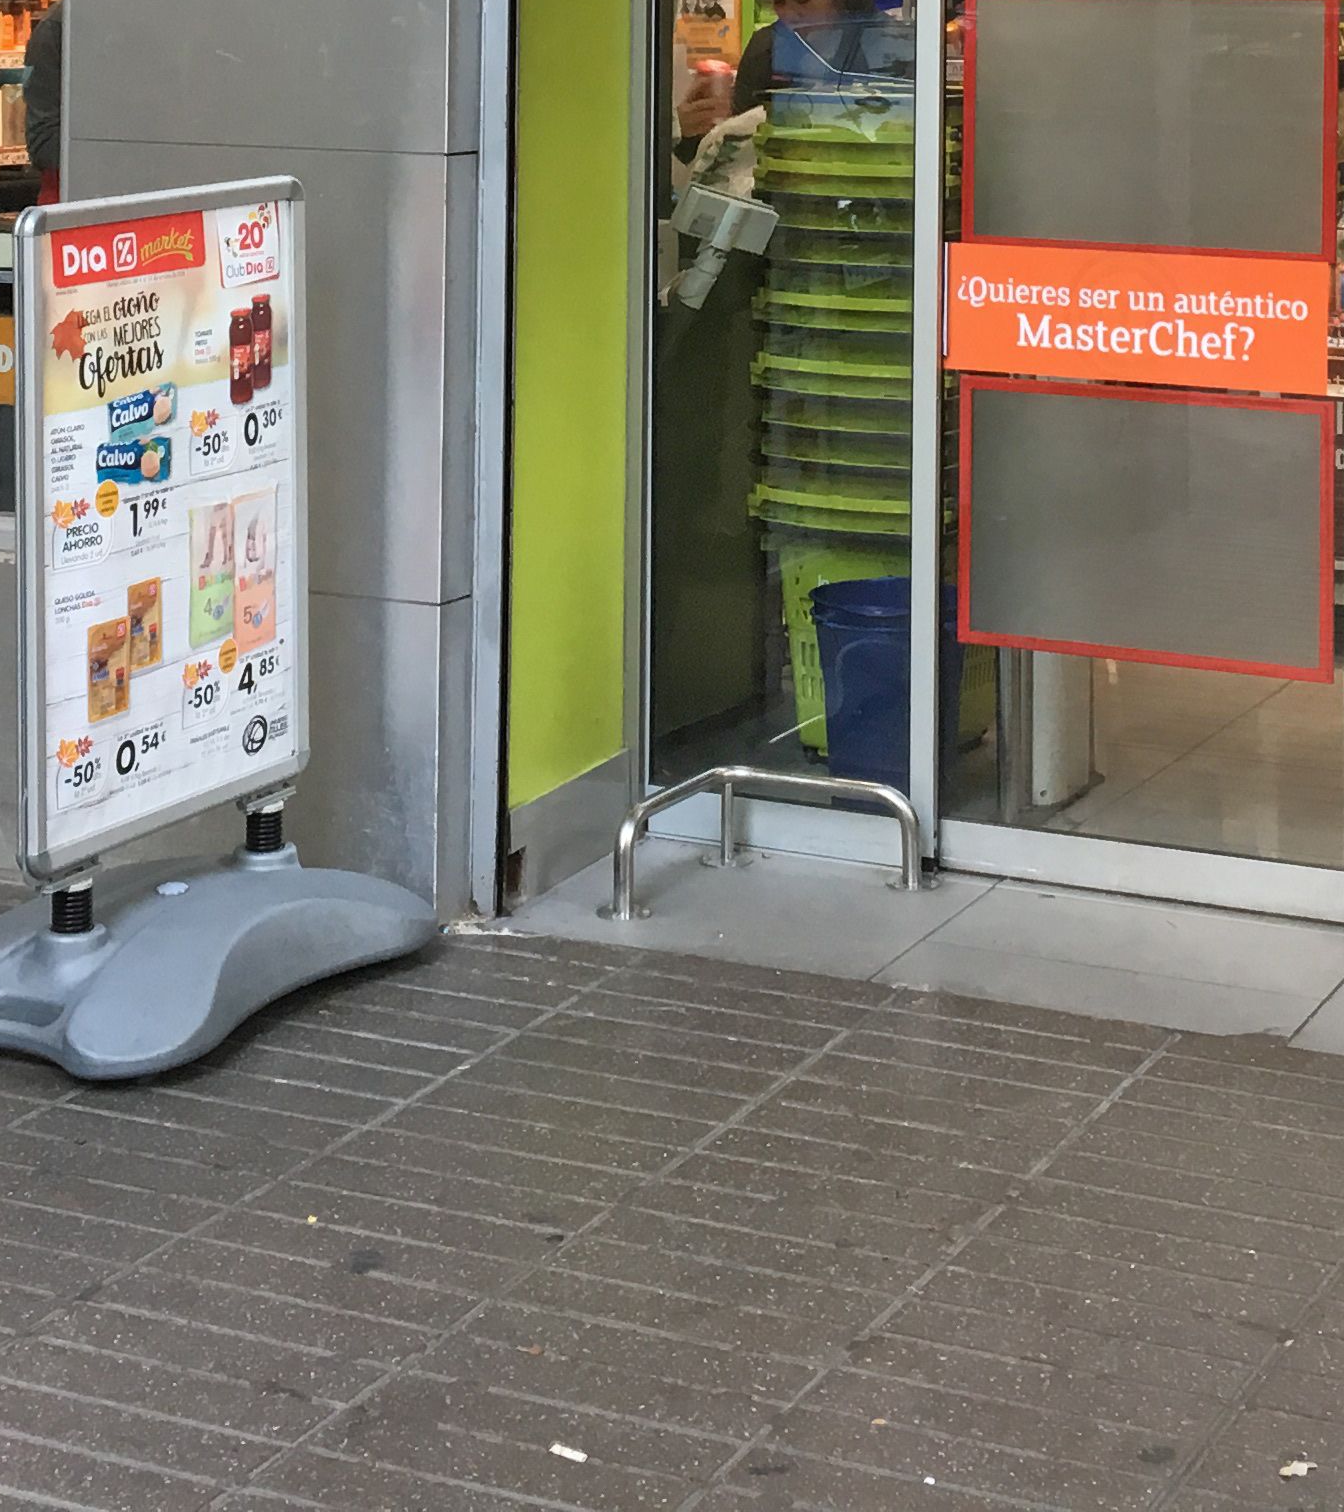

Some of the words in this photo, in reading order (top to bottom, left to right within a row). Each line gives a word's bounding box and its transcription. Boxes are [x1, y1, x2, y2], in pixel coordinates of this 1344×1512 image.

[140, 227, 194, 262] market
[238, 223, 264, 250] 20
[113, 291, 160, 320] otoño
[958, 276, 1070, 307] ¿Quieres
[1078, 290, 1117, 307] ser
[1128, 292, 1165, 312] un
[1174, 291, 1308, 321] auténtico
[1016, 314, 1255, 361] MasterChef?
[79, 340, 164, 398] Ofertas
[112, 402, 148, 427] Calvo
[98, 449, 136, 467] Calvo
[62, 535, 103, 553] AHORRO
[66, 522, 99, 538] PRECIO
